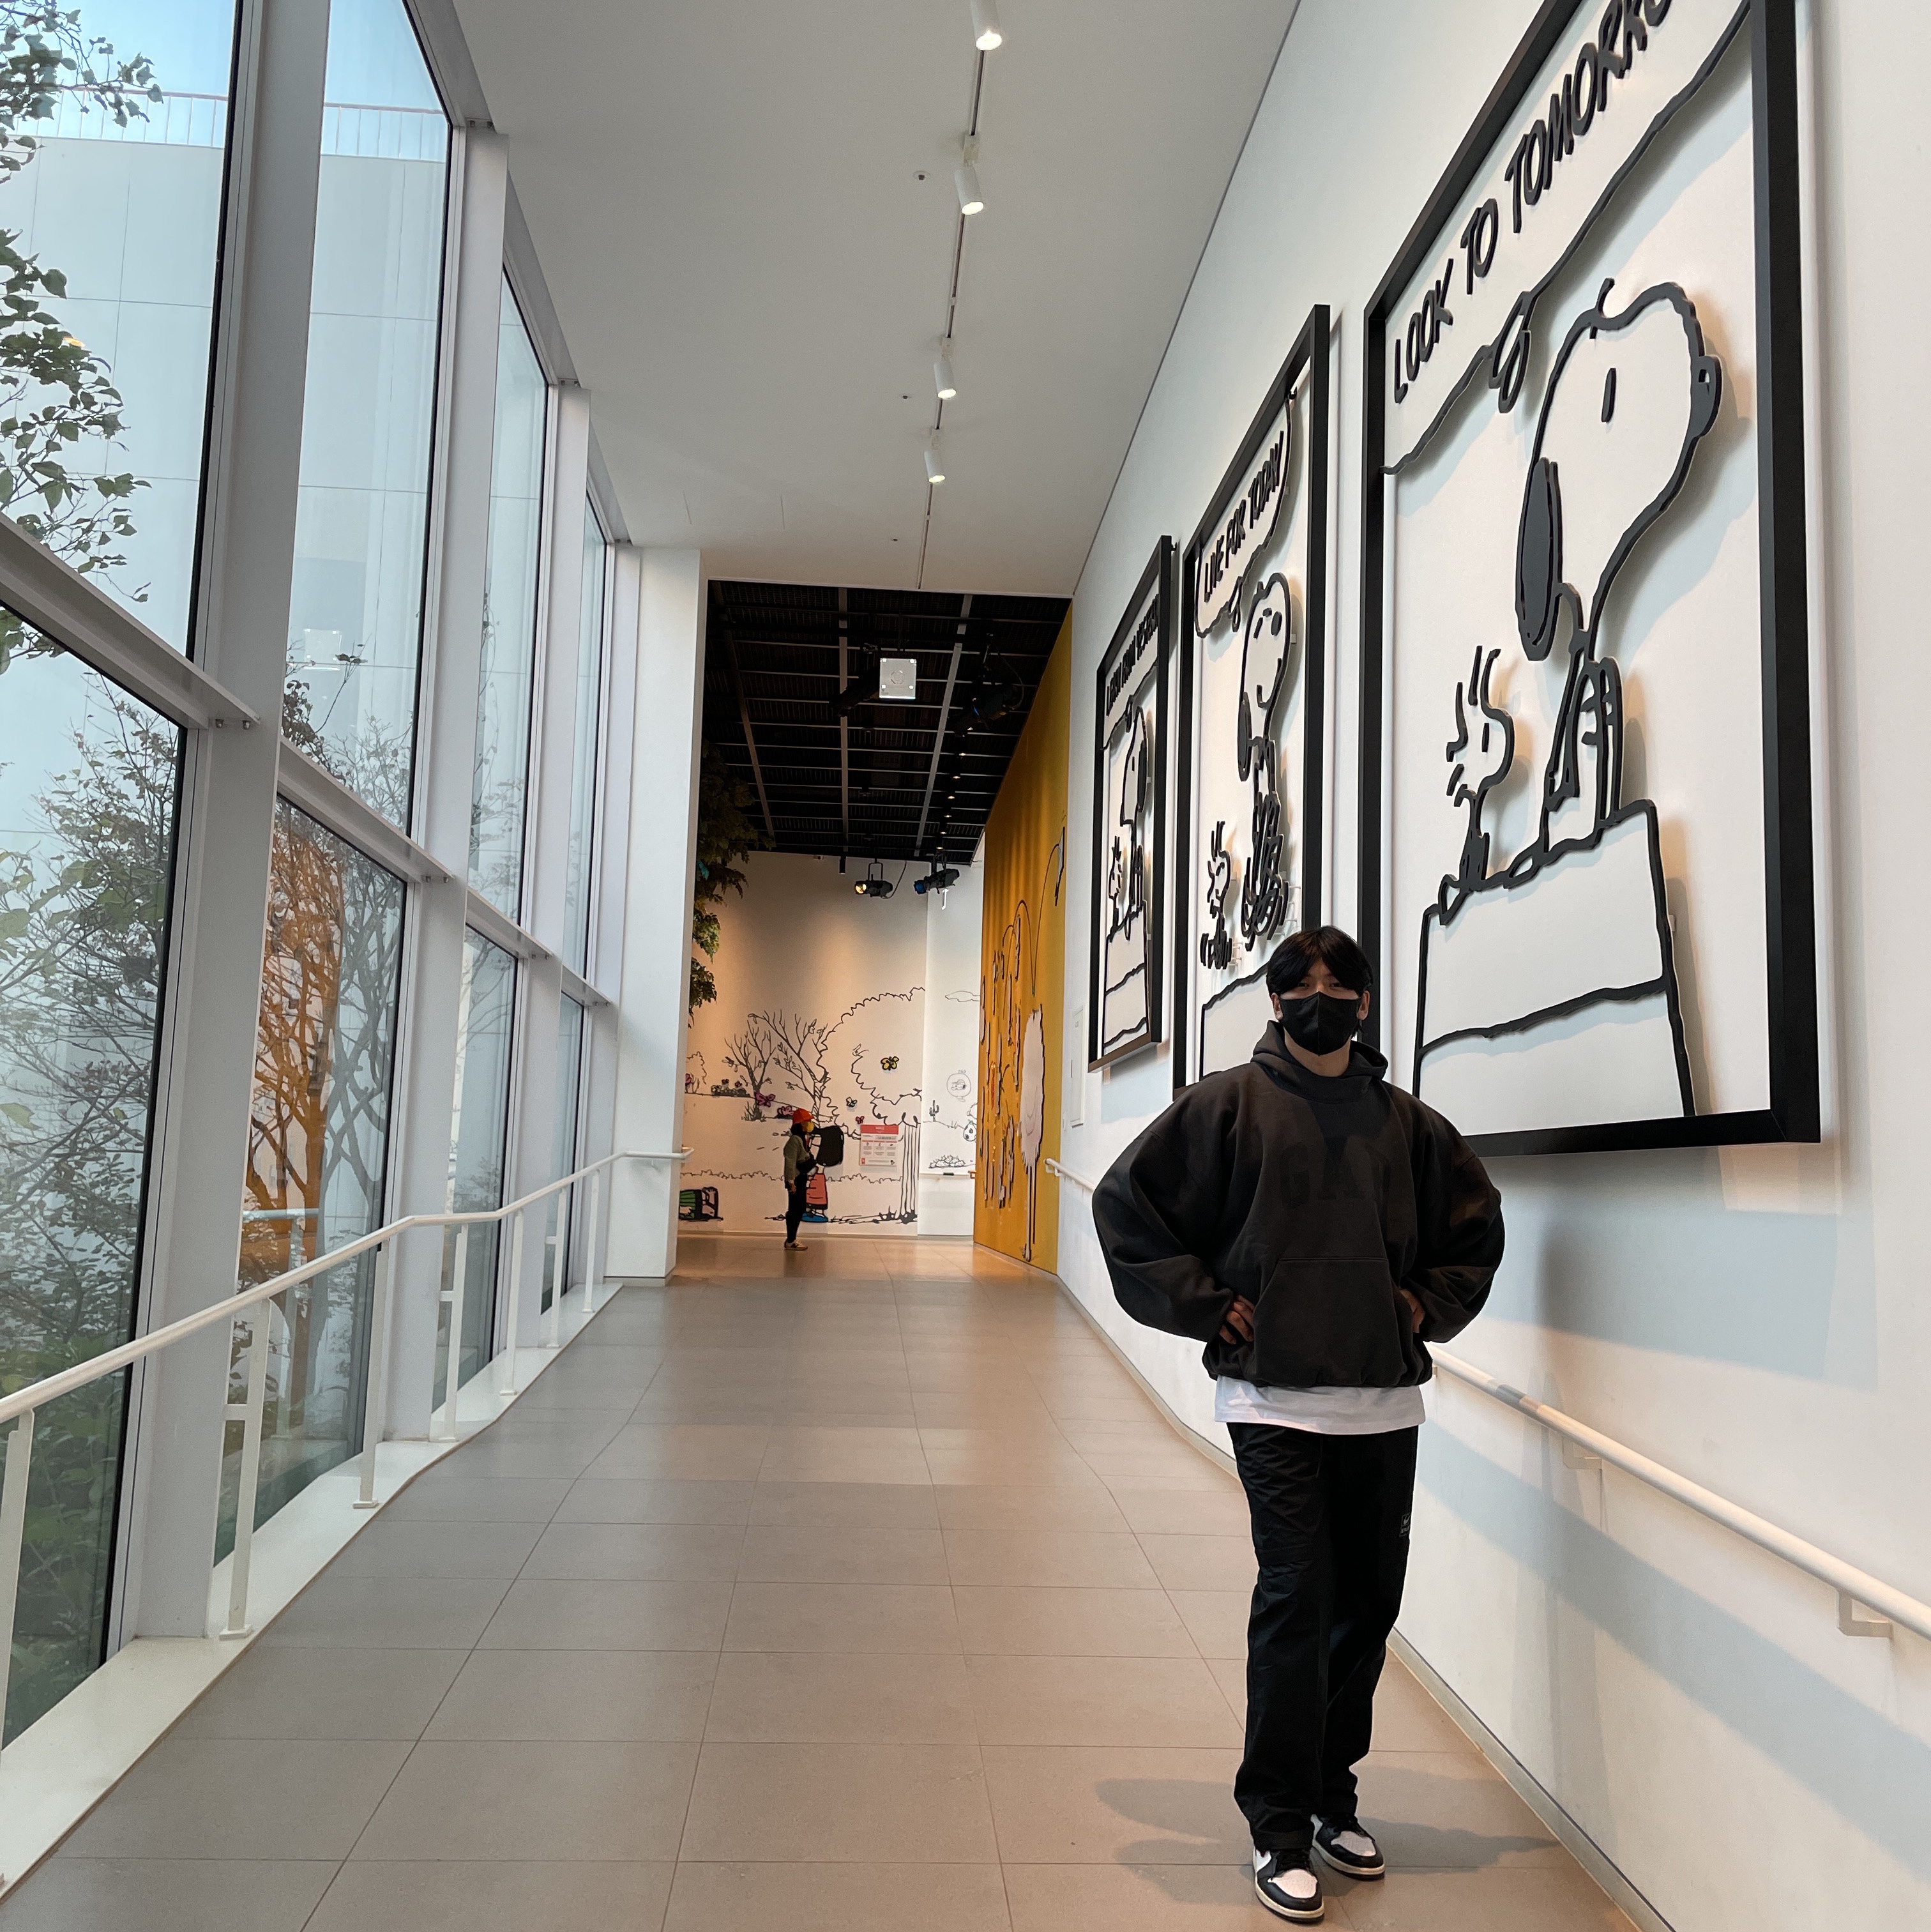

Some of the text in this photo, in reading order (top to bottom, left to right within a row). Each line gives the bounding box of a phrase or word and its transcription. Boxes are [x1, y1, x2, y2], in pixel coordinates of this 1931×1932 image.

[1394, 258, 1453, 404] LOOK
[1460, 199, 1498, 294] TO
[1248, 430, 1284, 529] TODAY
